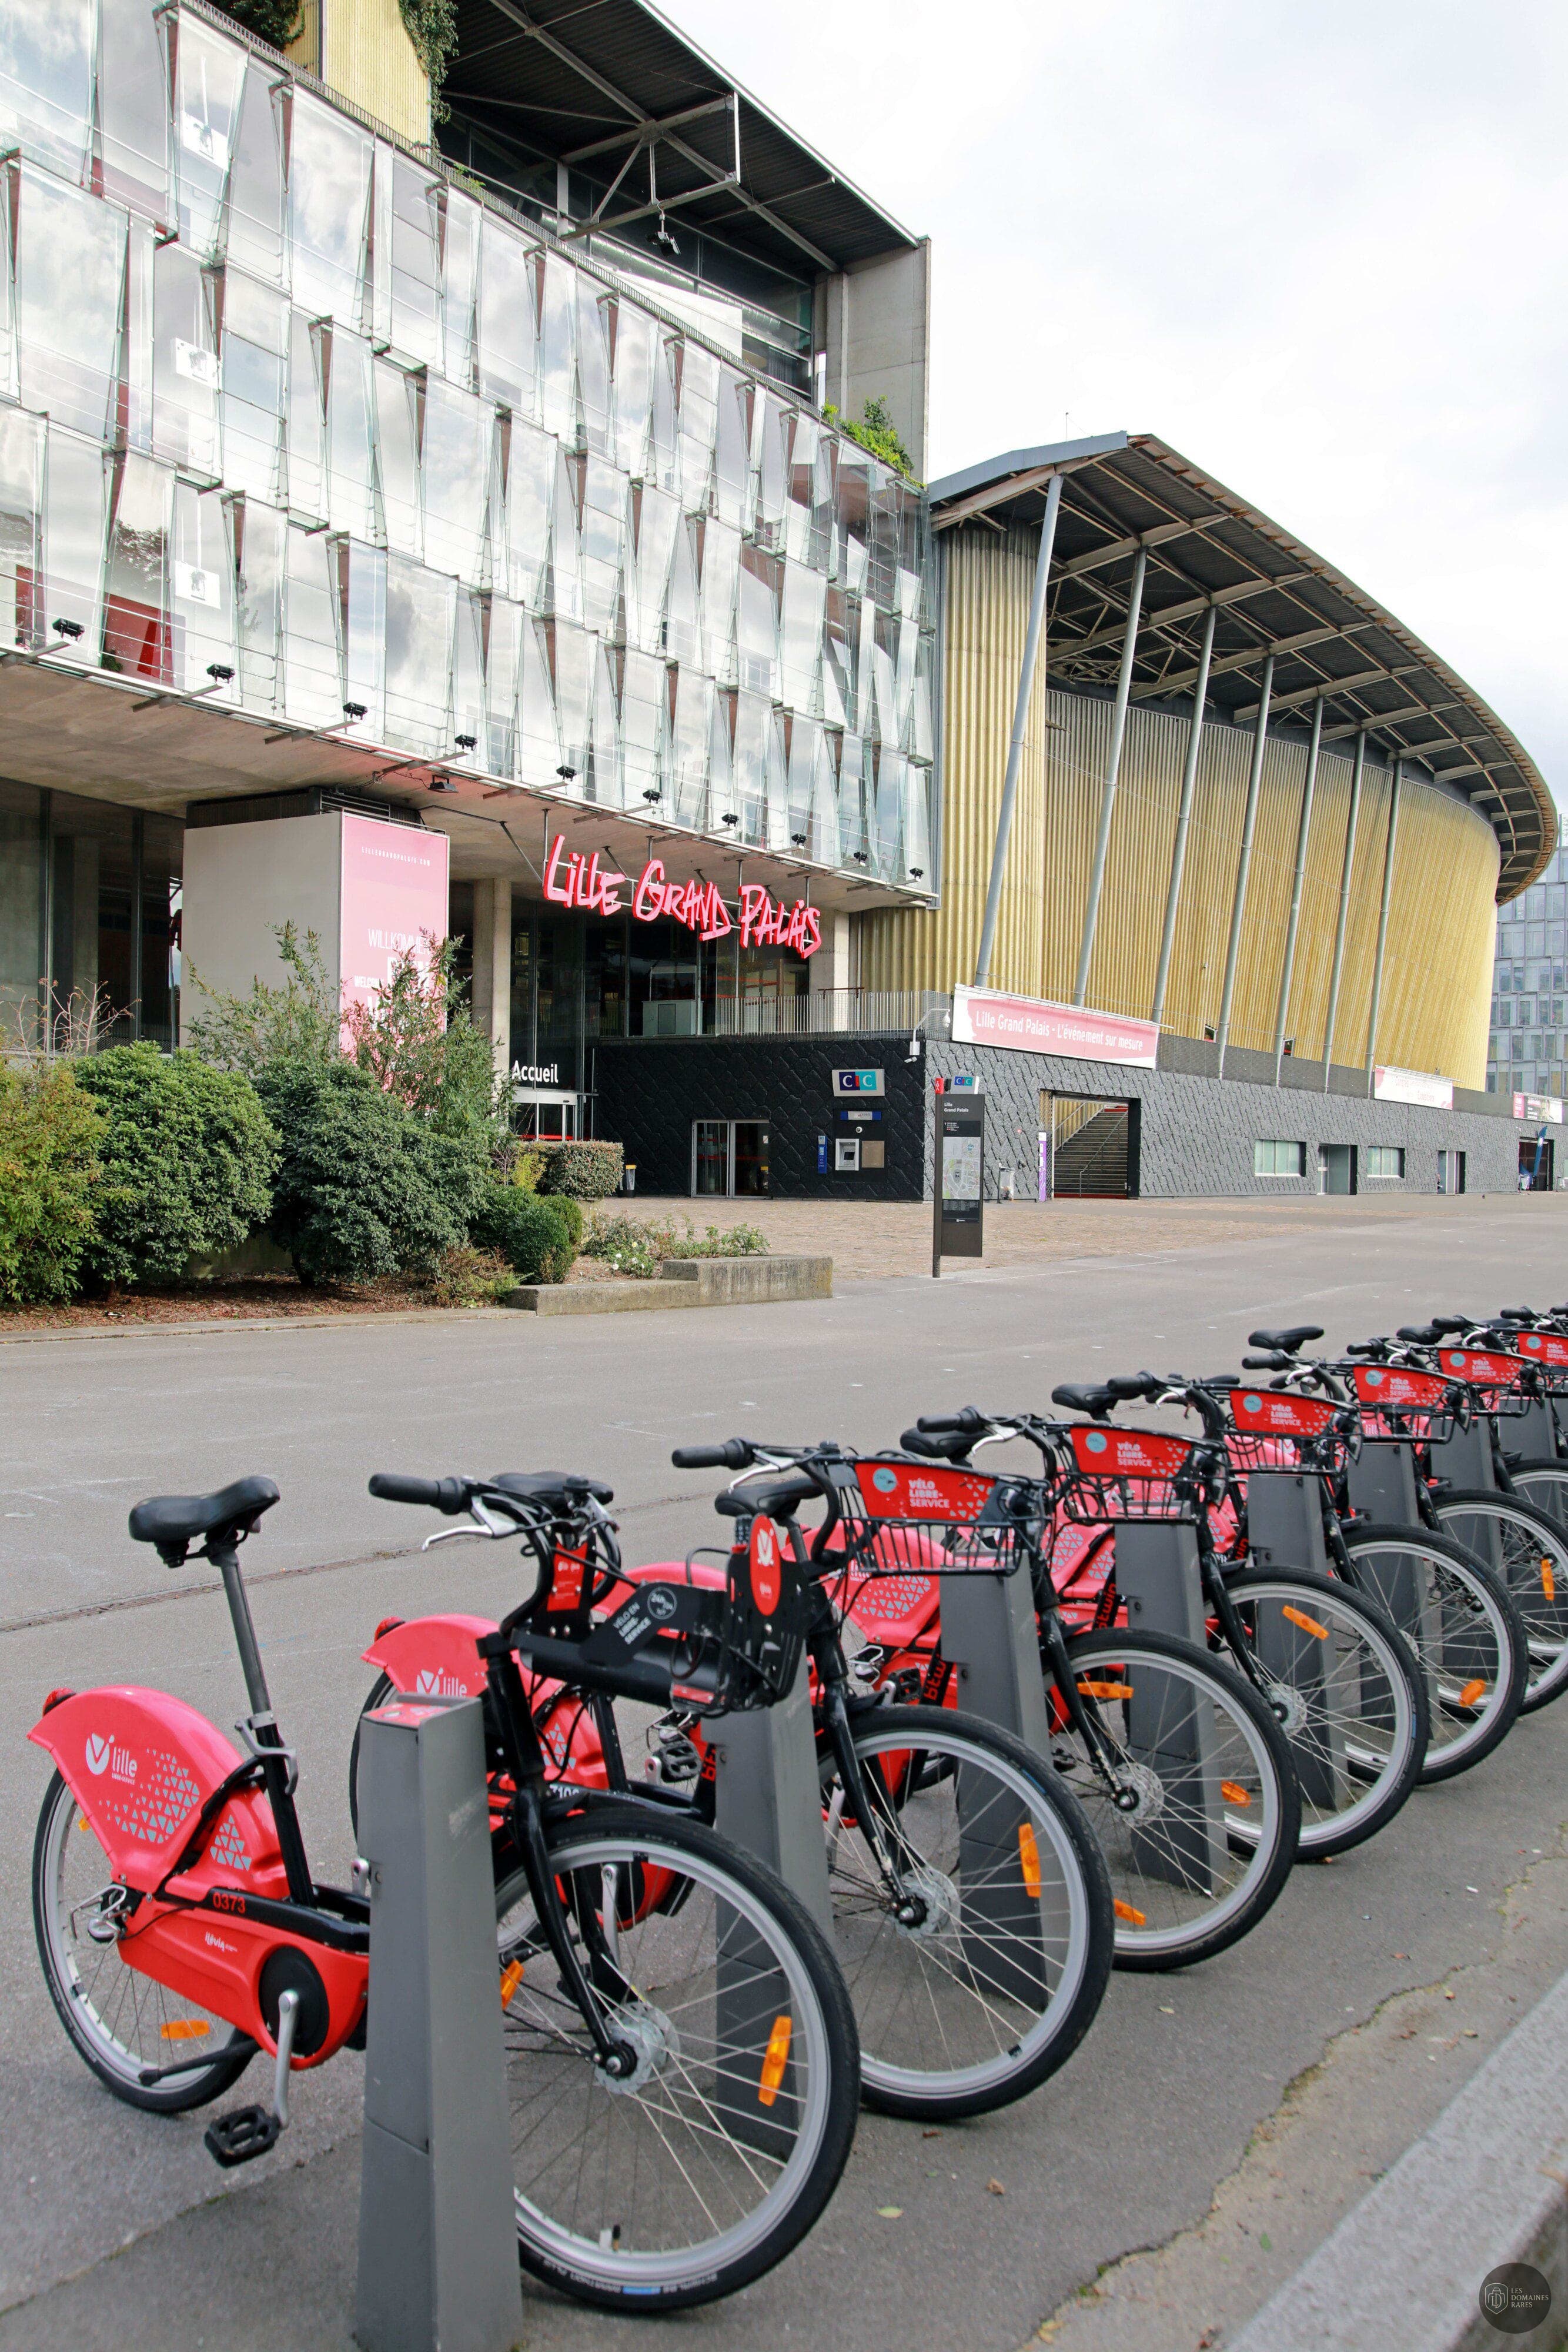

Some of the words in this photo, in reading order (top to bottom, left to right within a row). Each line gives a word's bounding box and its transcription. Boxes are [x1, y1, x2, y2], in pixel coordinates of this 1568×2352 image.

[633, 860, 732, 941] GRAND
[976, 1011, 995, 1028] Lille
[998, 1014, 1023, 1033] Grand
[1026, 1018, 1049, 1037] Palais
[1057, 1023, 1104, 1045] L'événement
[1105, 1035, 1117, 1046] sur
[1118, 1038, 1143, 1051] mesure
[511, 1060, 559, 1083] Accueil
[842, 1075, 872, 1087] CIC
[1271, 1418, 1301, 1426] SERVICE
[1117, 1441, 1141, 1451] VÉLO
[1118, 1458, 1152, 1467] SERVICE
[908, 1477, 935, 1489] VÉLO
[910, 1499, 950, 1508] SERVICE
[625, 1616, 651, 1645] SERVICE
[112, 1746, 137, 1777] lille
[213, 1892, 246, 1914] 0373
